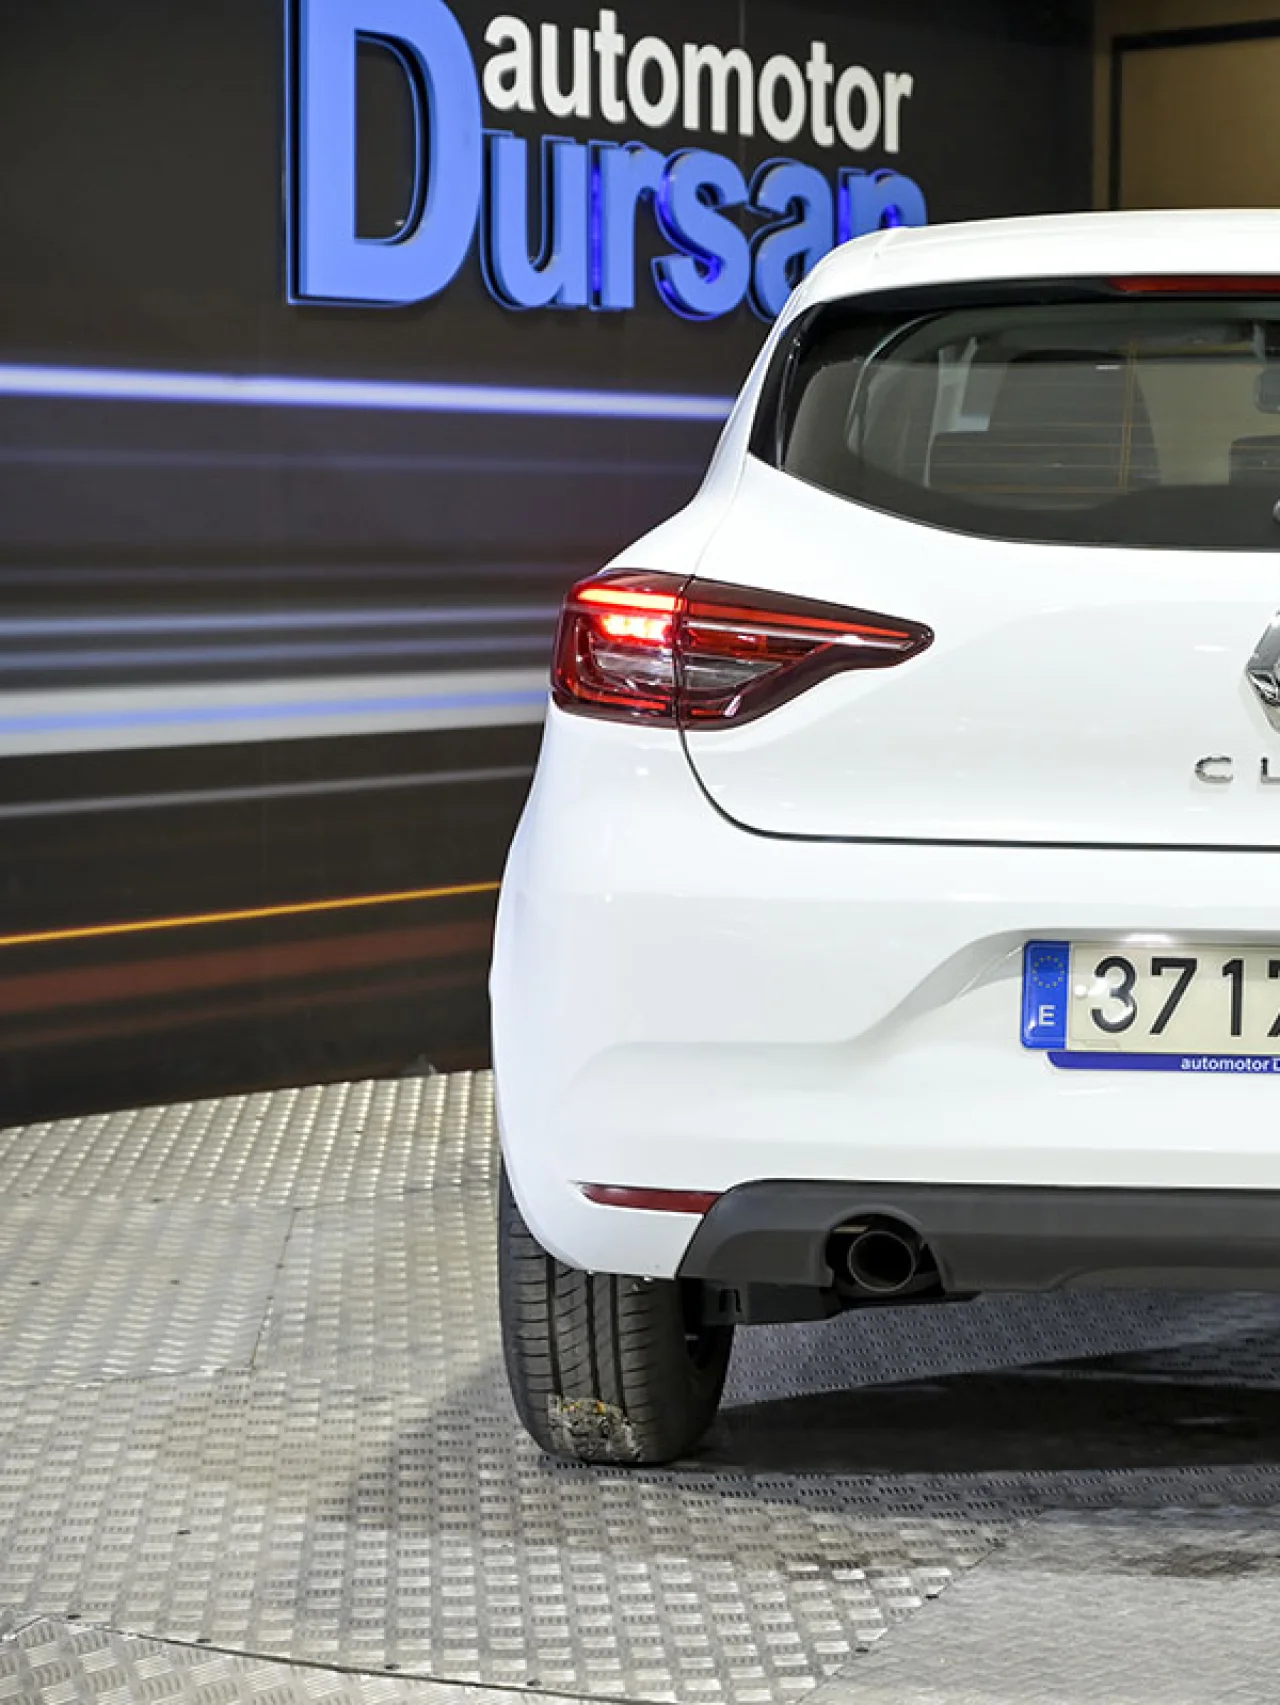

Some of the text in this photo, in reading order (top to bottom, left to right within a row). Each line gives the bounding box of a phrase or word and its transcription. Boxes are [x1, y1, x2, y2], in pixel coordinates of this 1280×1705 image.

[483, 9, 912, 153] automotor
[1039, 1004, 1057, 1026] E
[1181, 1057, 1270, 1072] automotor
